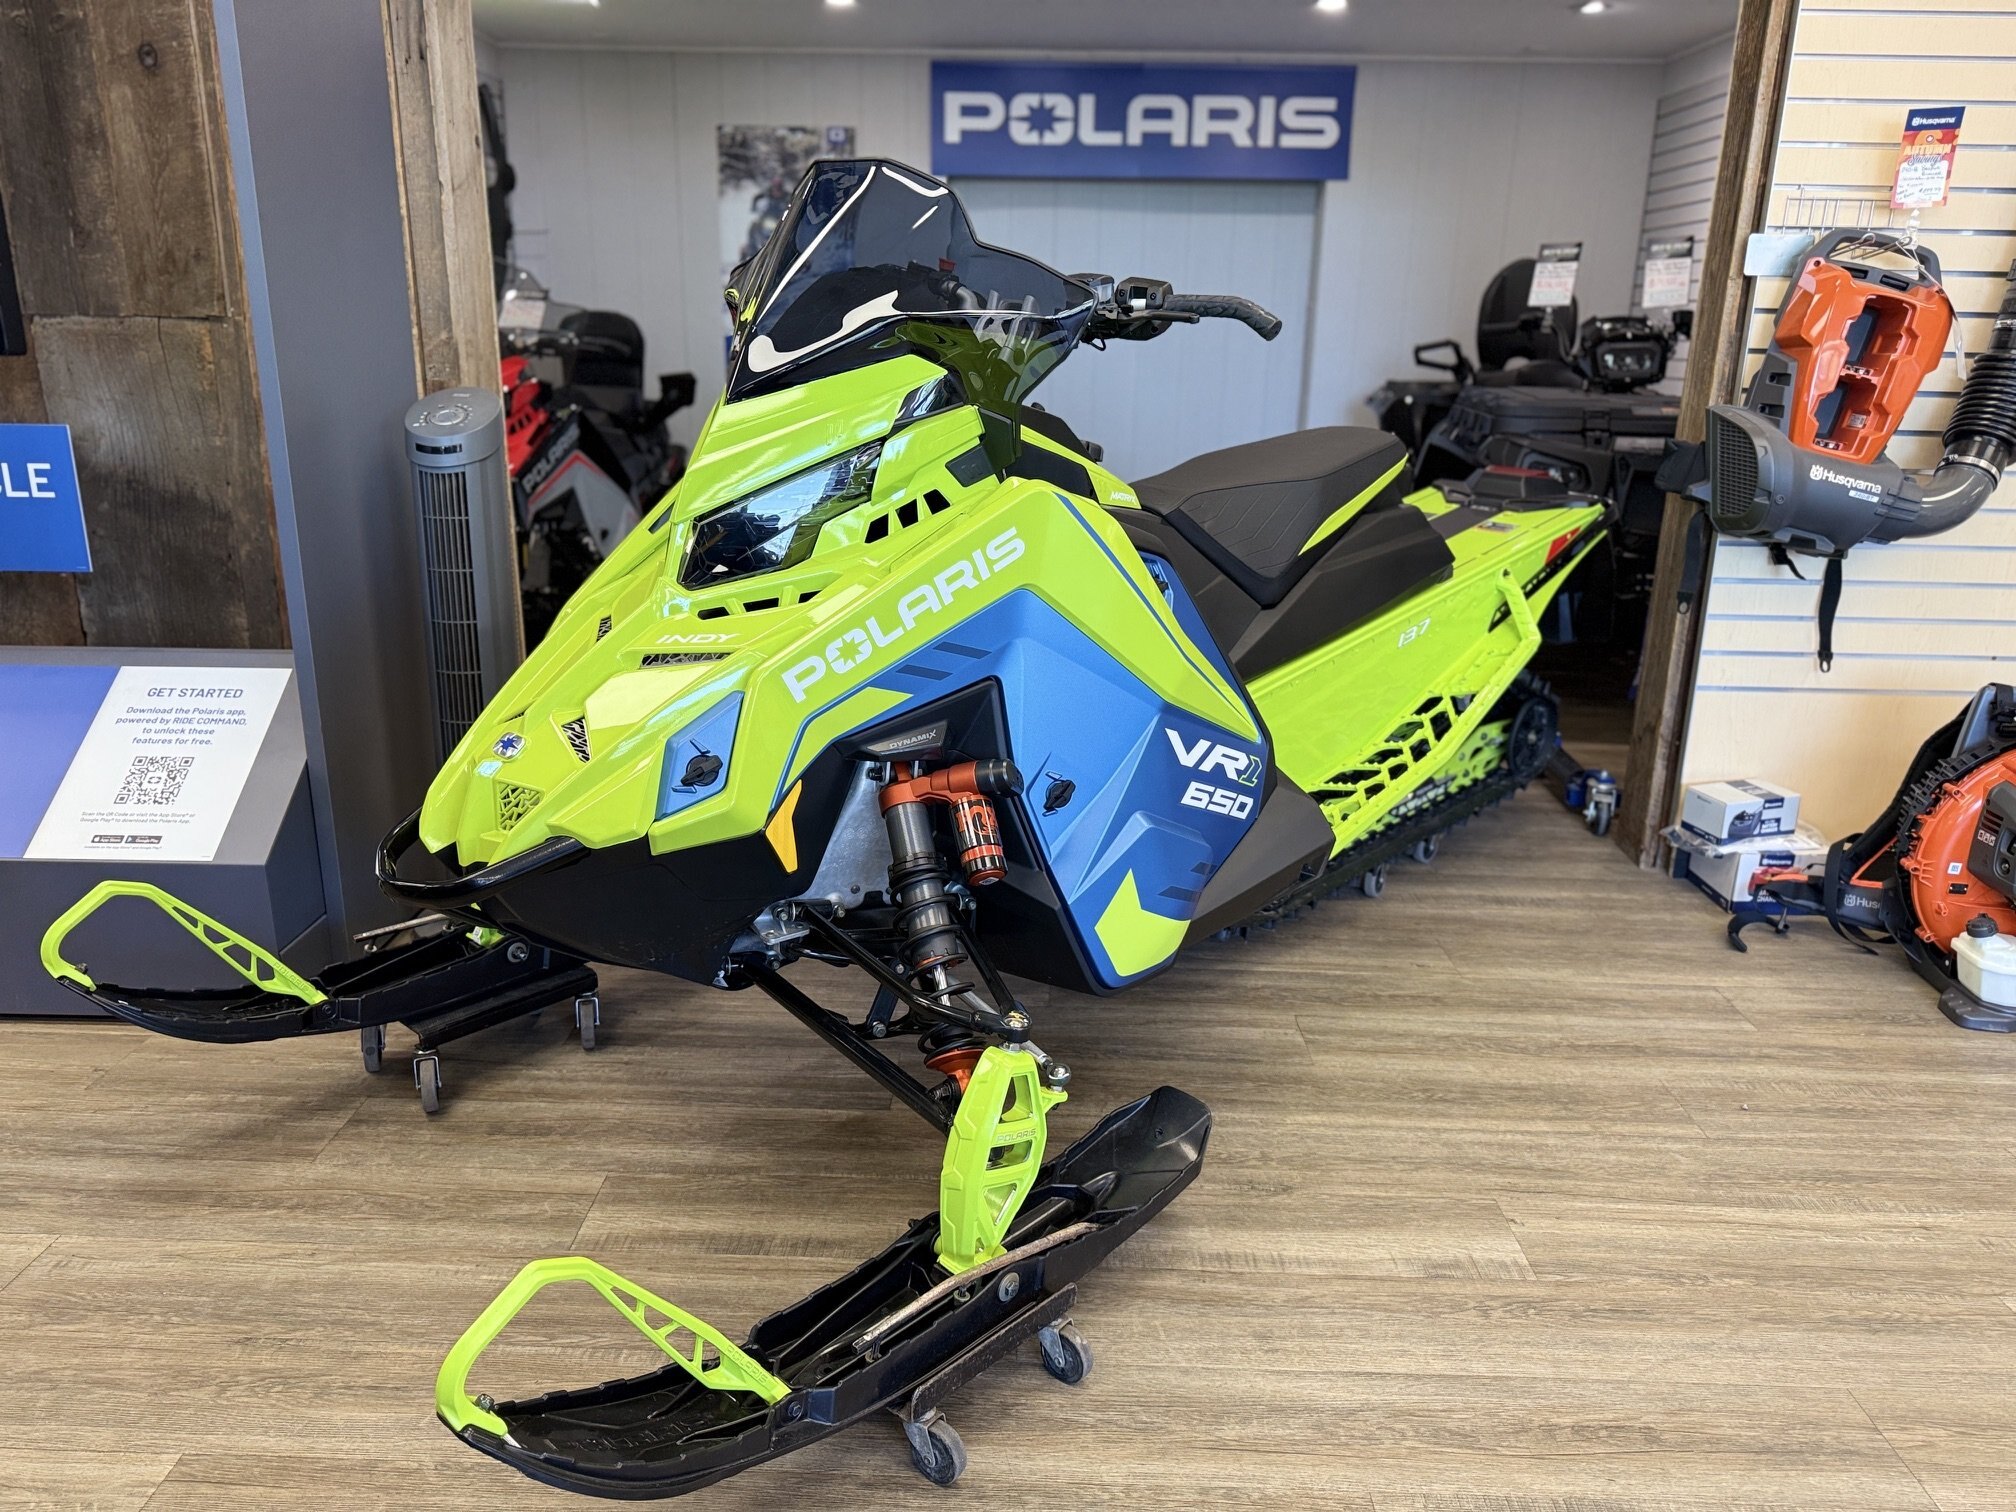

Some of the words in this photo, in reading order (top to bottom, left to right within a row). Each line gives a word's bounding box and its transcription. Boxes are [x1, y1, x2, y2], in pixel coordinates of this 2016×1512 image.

[943, 91, 1342, 150] POLARIS
[1919, 116, 1957, 125] Husqvarna
[1903, 144, 1952, 155] AUTUMN
[1907, 153, 1944, 167] Savings
[521, 422, 580, 494] POLARIS
[0, 462, 56, 498] LE
[1822, 469, 1882, 494] Husqvarna
[781, 526, 1026, 703] POLARIS
[655, 633, 741, 644] INDY
[1398, 617, 1431, 648] 137
[147, 687, 176, 698] GET
[178, 688, 243, 699] STARTED
[126, 706, 173, 714] Download
[192, 707, 225, 715] Polaris
[115, 717, 158, 725] powered
[159, 717, 172, 726] by
[172, 717, 196, 725] RIDE
[197, 718, 247, 726] COMMAND,
[154, 727, 186, 735] unlock
[889, 729, 937, 749] DYNAMIX
[132, 737, 172, 745] features
[174, 737, 188, 745] for
[190, 737, 213, 745] free.
[1164, 727, 1263, 787] VR1
[1180, 780, 1254, 820] 650
[997, 1128, 1037, 1141] POLARIS
[727, 1344, 769, 1384] POLARIS
